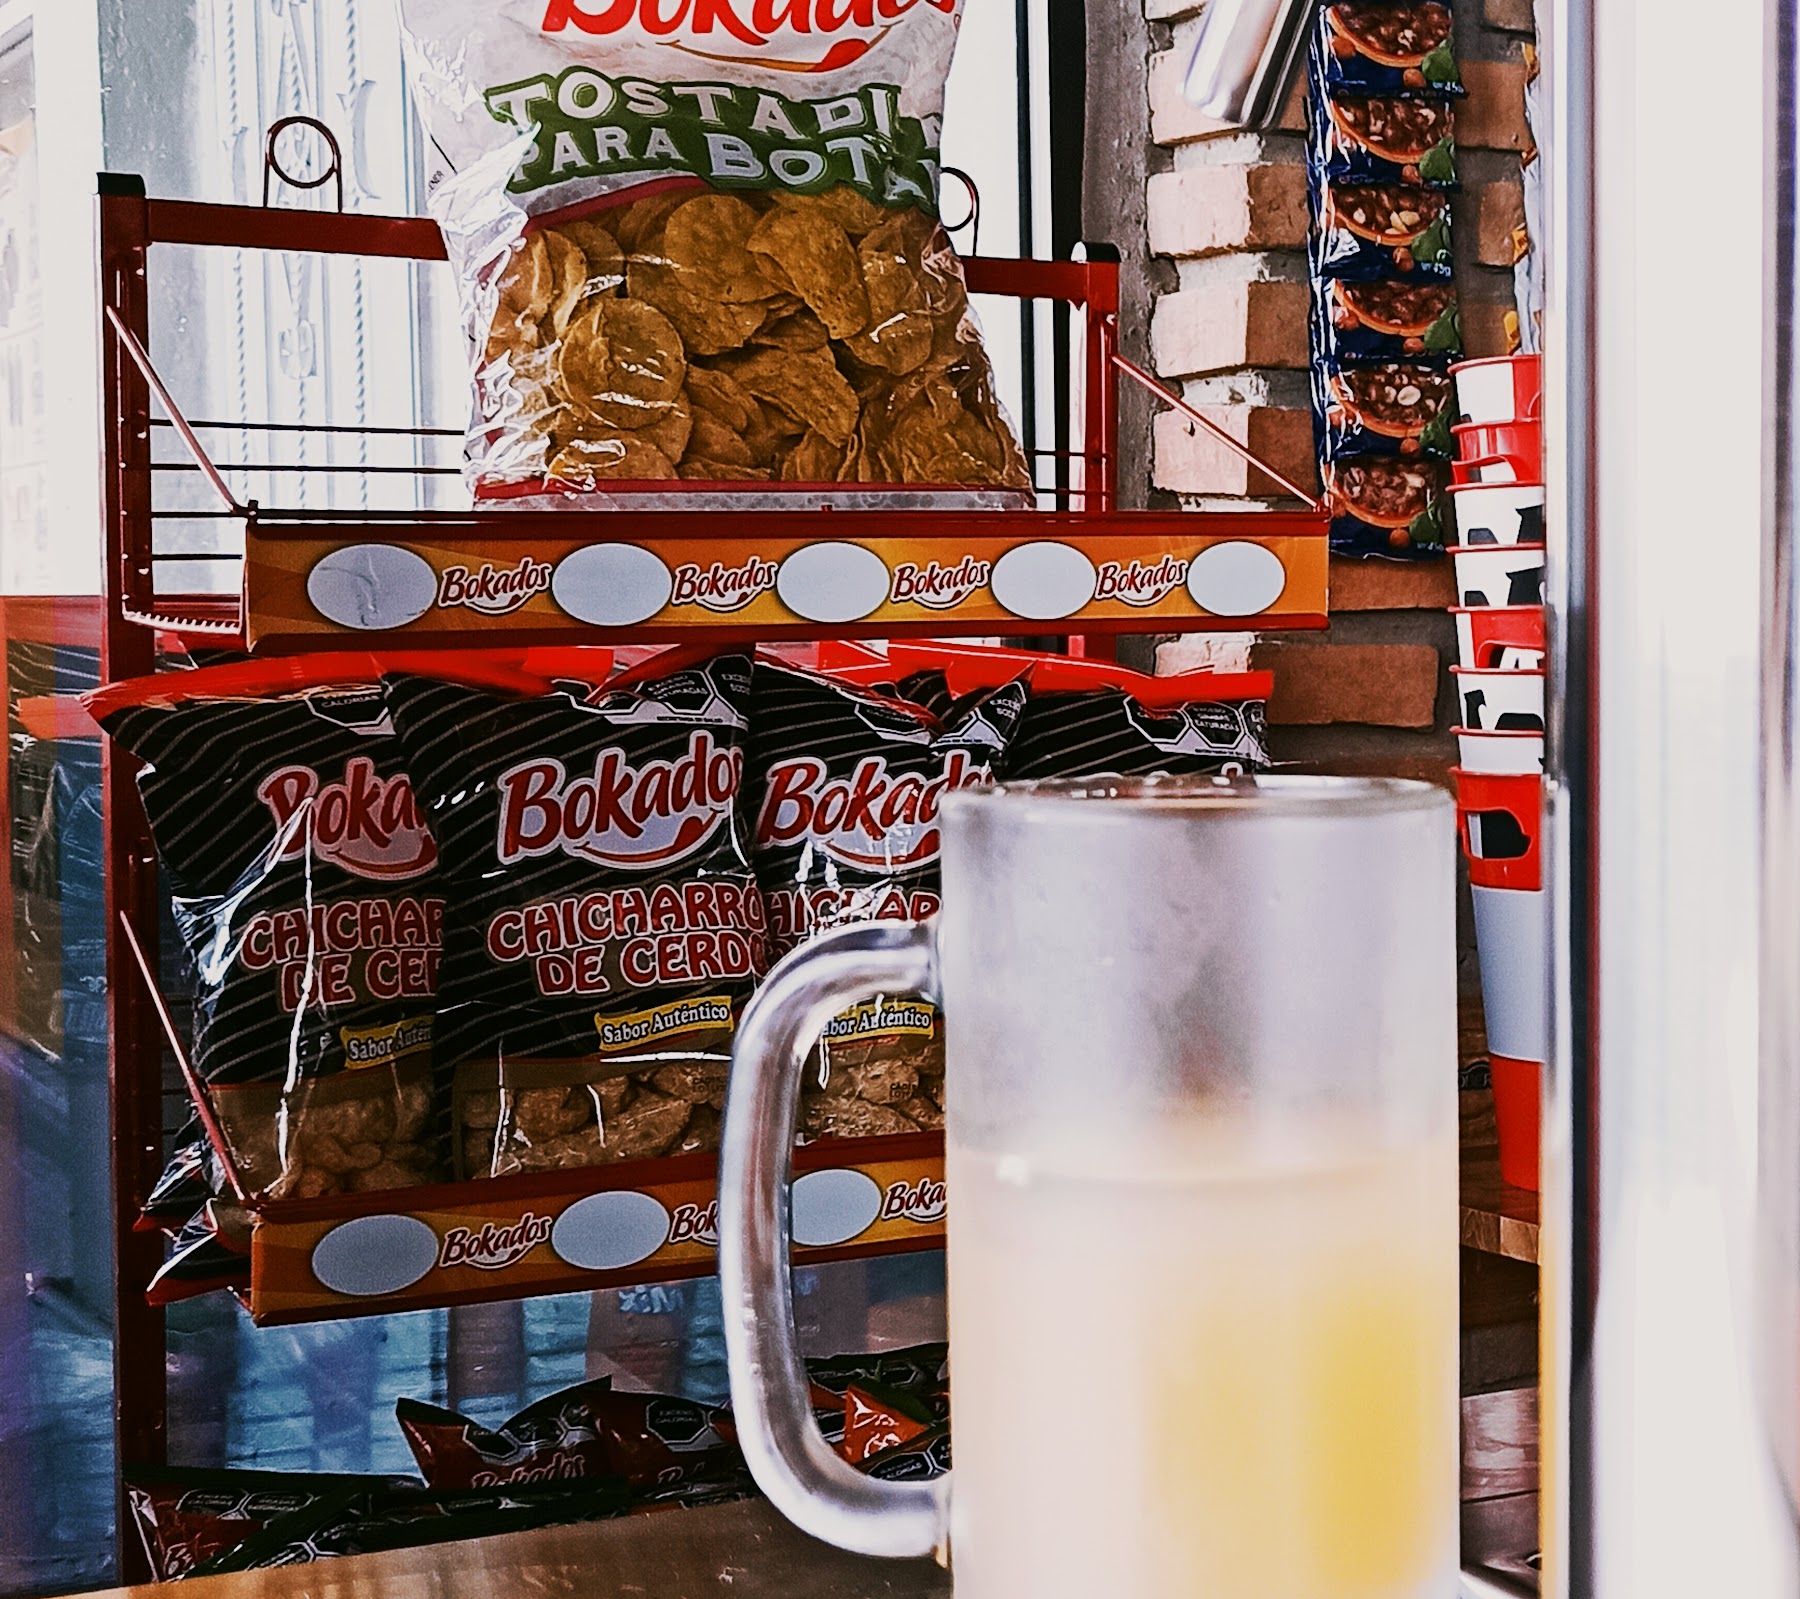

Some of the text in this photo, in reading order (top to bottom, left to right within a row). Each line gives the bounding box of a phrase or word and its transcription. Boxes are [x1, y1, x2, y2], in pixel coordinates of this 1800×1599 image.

[510, 125, 689, 183] PARA
[440, 554, 1189, 601] Bokados Bokados Bokados Bokados
[262, 763, 425, 855] Boka
[281, 953, 356, 1013] DE
[536, 945, 611, 996] DE
[349, 1035, 395, 1061] Sabor
[603, 1004, 729, 1044] Sabor Auténtico
[822, 1018, 855, 1037] abor
[439, 1212, 552, 1267] Bokados
[881, 1179, 947, 1219] Boka
